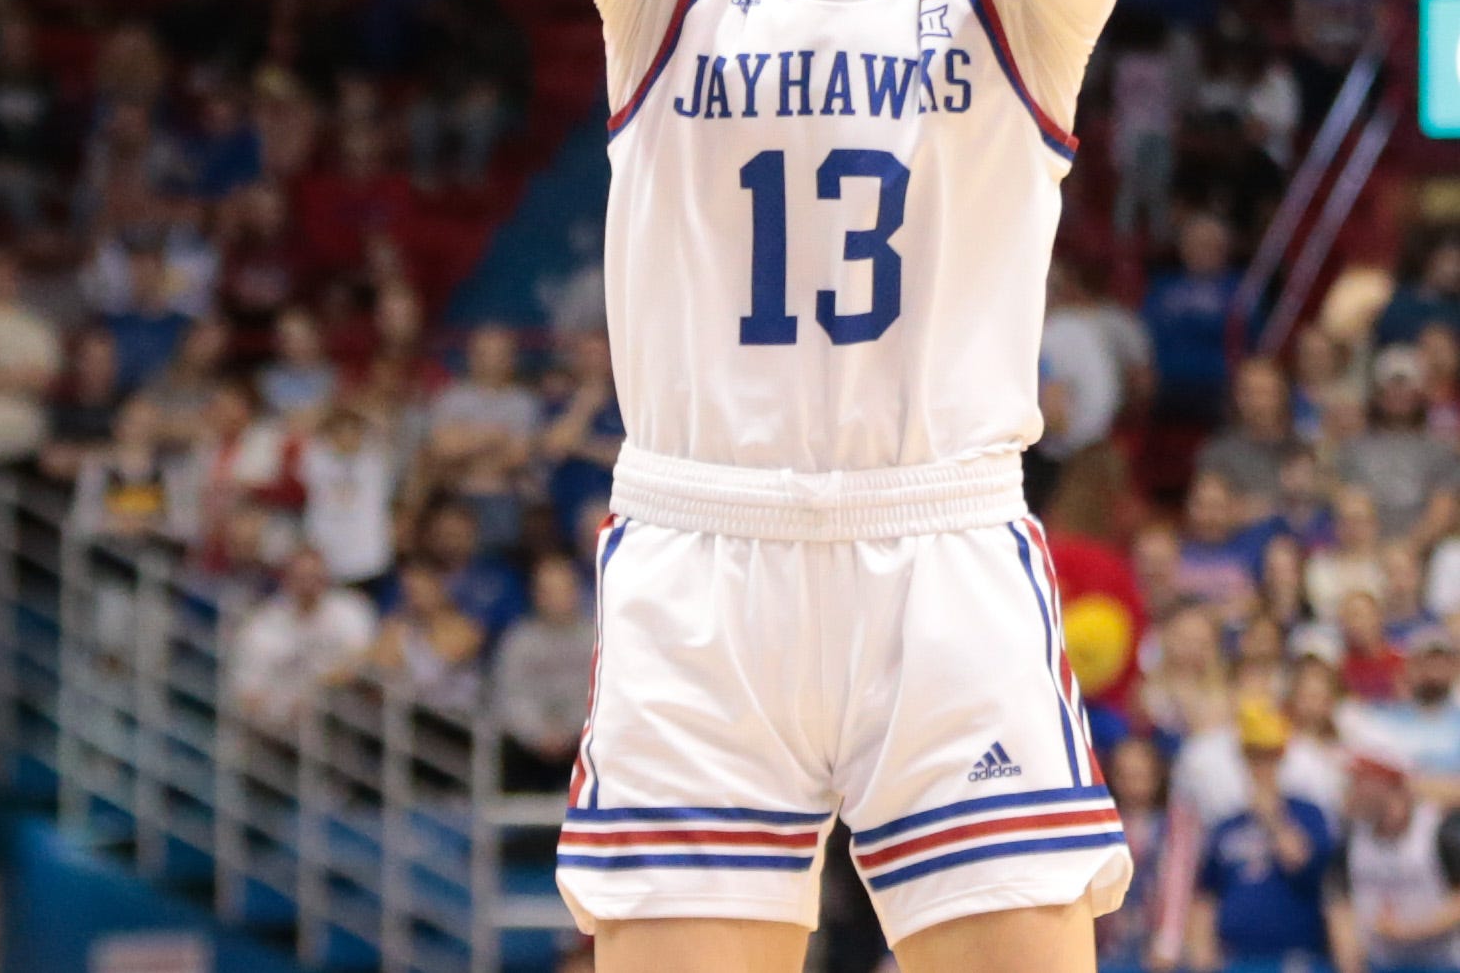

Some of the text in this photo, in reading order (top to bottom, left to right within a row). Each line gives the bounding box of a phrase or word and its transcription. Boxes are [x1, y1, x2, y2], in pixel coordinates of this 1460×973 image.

[674, 48, 972, 120] JAYHAWKS
[739, 149, 911, 346] 13
[968, 764, 1022, 783] adidas
